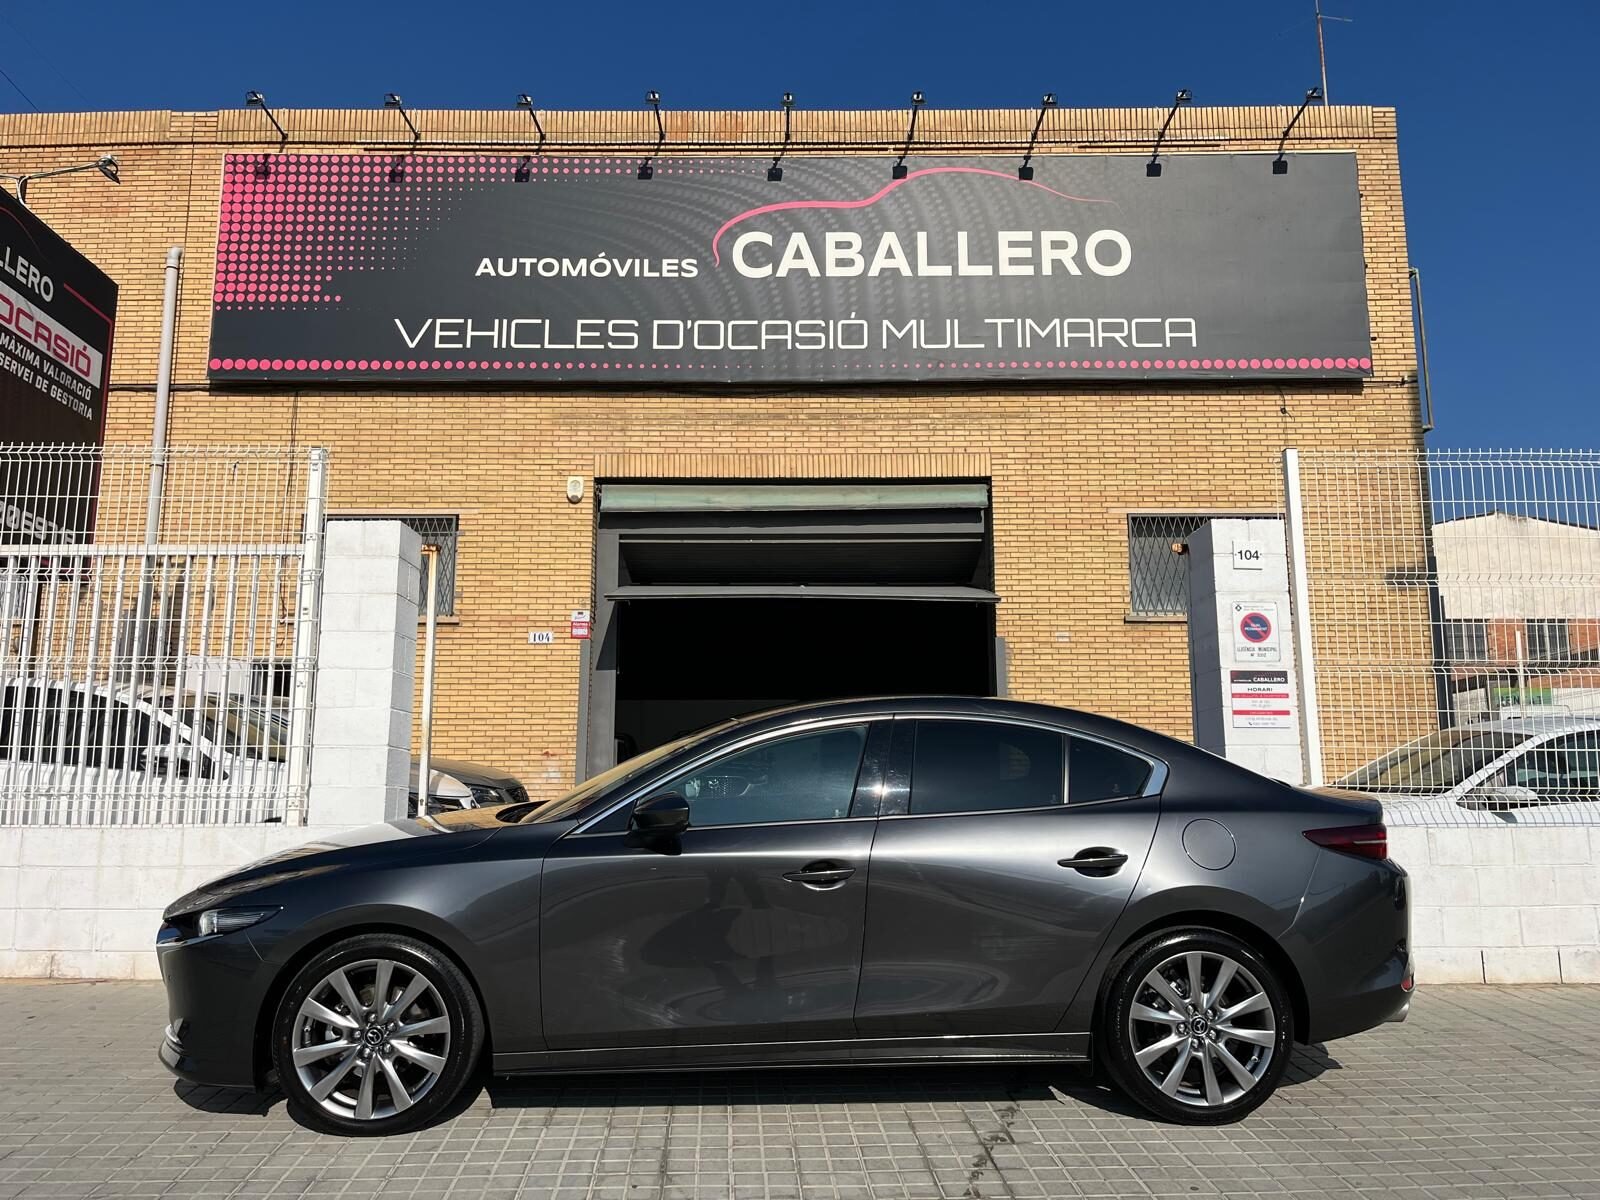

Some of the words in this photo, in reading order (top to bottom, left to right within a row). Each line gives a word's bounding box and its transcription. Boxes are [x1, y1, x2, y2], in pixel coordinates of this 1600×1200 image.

[475, 252, 699, 278] AUTOMÓVILES
[732, 229, 1132, 279] CABALLERO
[394, 318, 639, 349] VEHICLES
[653, 311, 868, 350] D'OCASIÓ
[882, 317, 1197, 349] MULTIMARCA
[0, 351, 34, 384] SERVEI
[35, 375, 49, 393] DE
[50, 385, 93, 421] GESTORIA
[43, 359, 92, 401] VALORACIÓ
[1237, 549, 1260, 561] 104
[533, 632, 550, 642] 104
